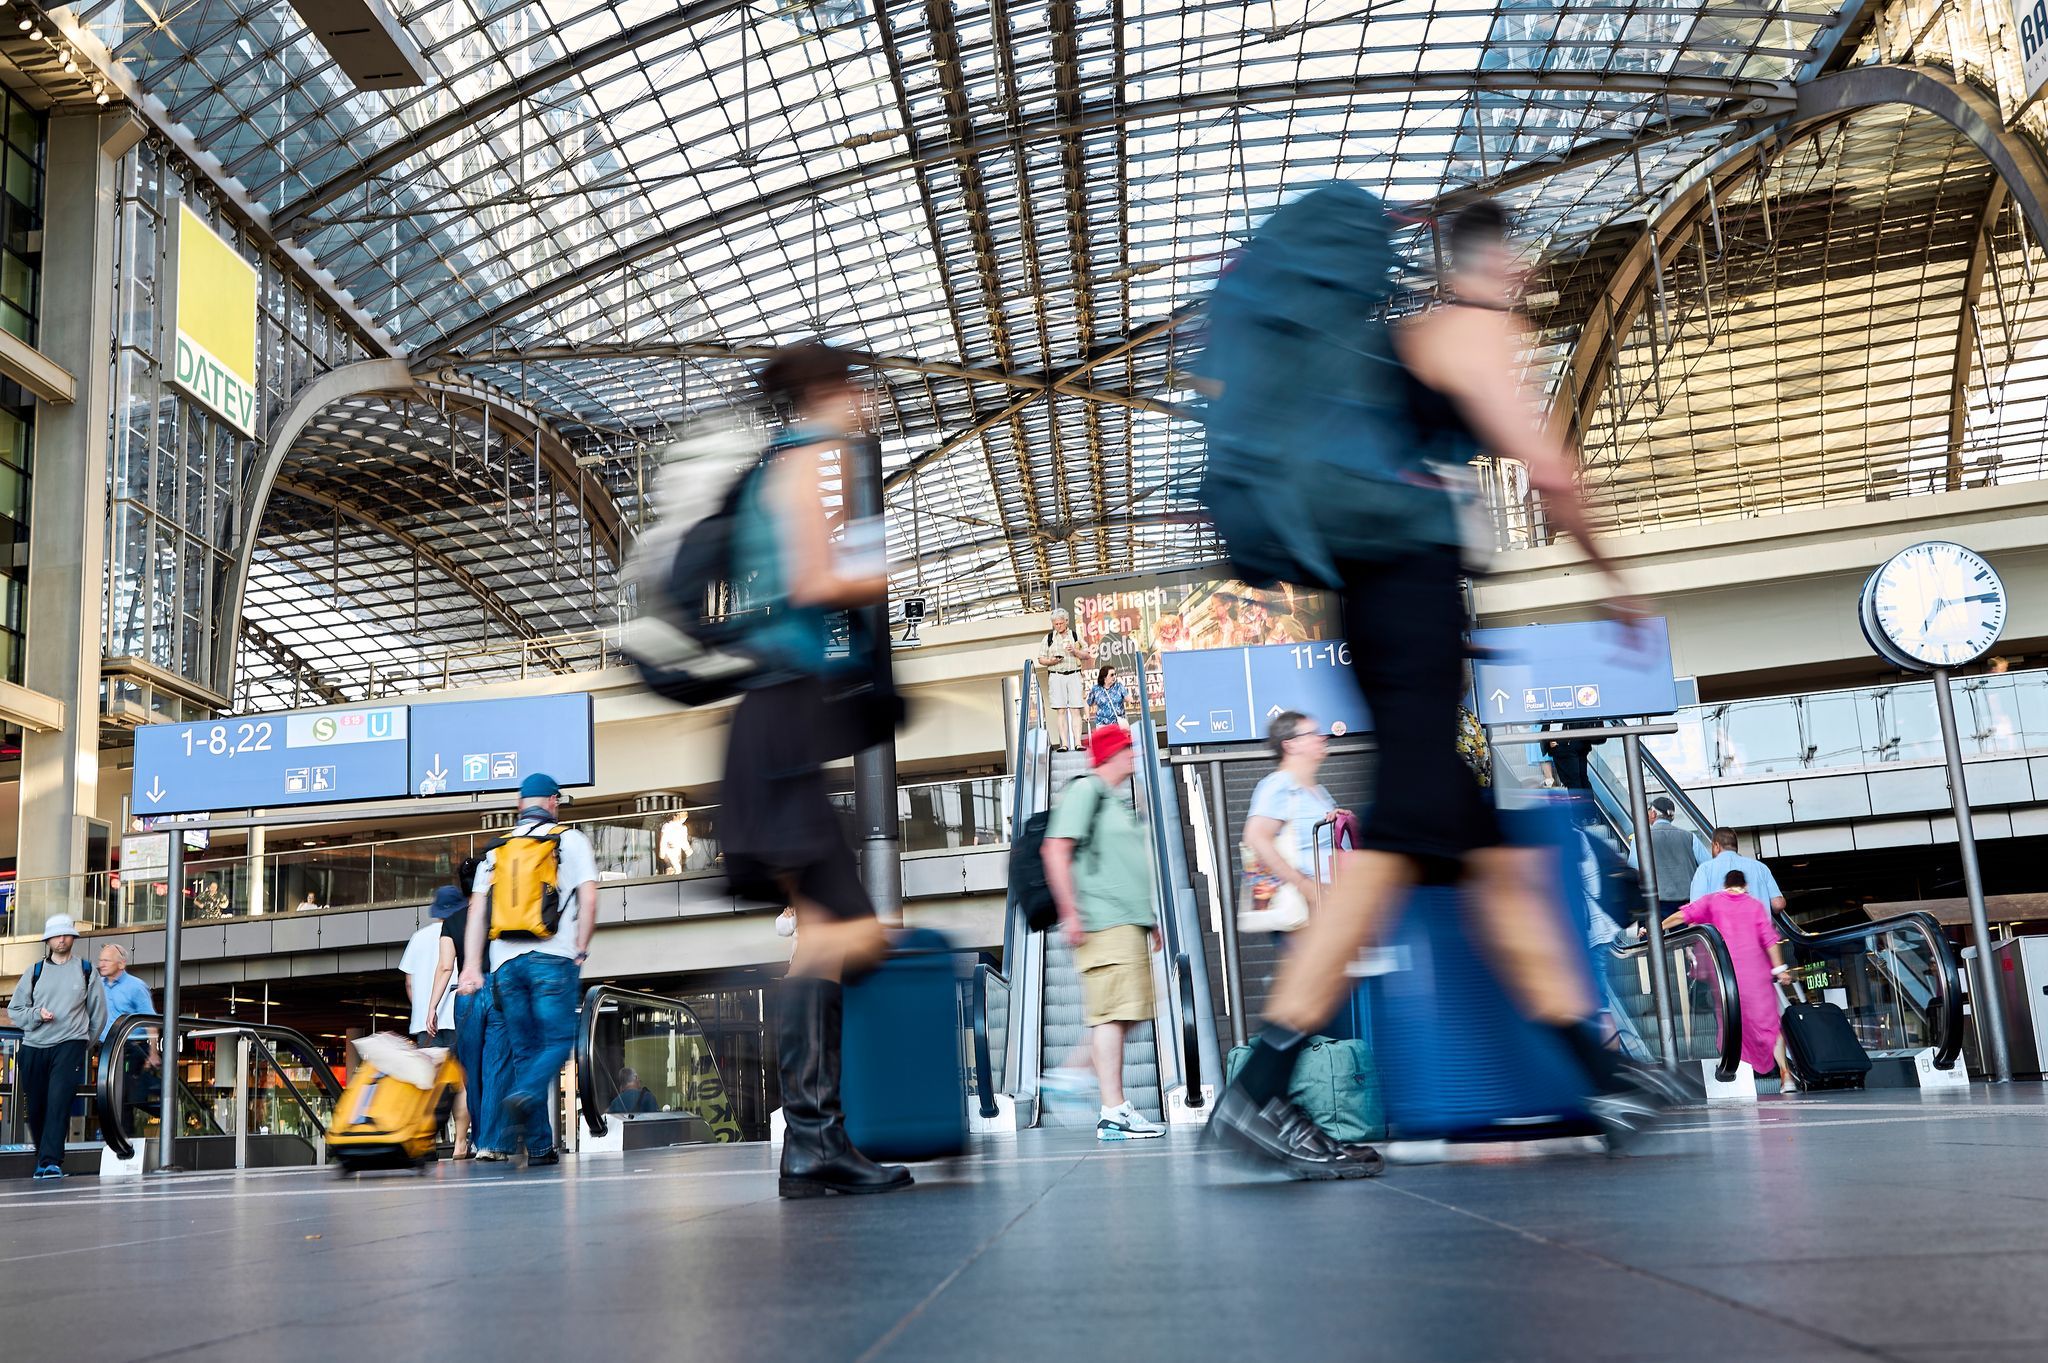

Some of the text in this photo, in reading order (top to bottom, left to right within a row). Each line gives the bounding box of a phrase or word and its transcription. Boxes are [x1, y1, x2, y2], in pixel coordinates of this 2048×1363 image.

[177, 337, 254, 428] DATEV
[1074, 586, 1168, 619] Spiel nach
[1076, 616, 1132, 640] neuen
[1291, 642, 1353, 669] 11-16
[371, 713, 388, 737] U
[1212, 720, 1229, 730] WC
[181, 722, 273, 758] 1-8,22
